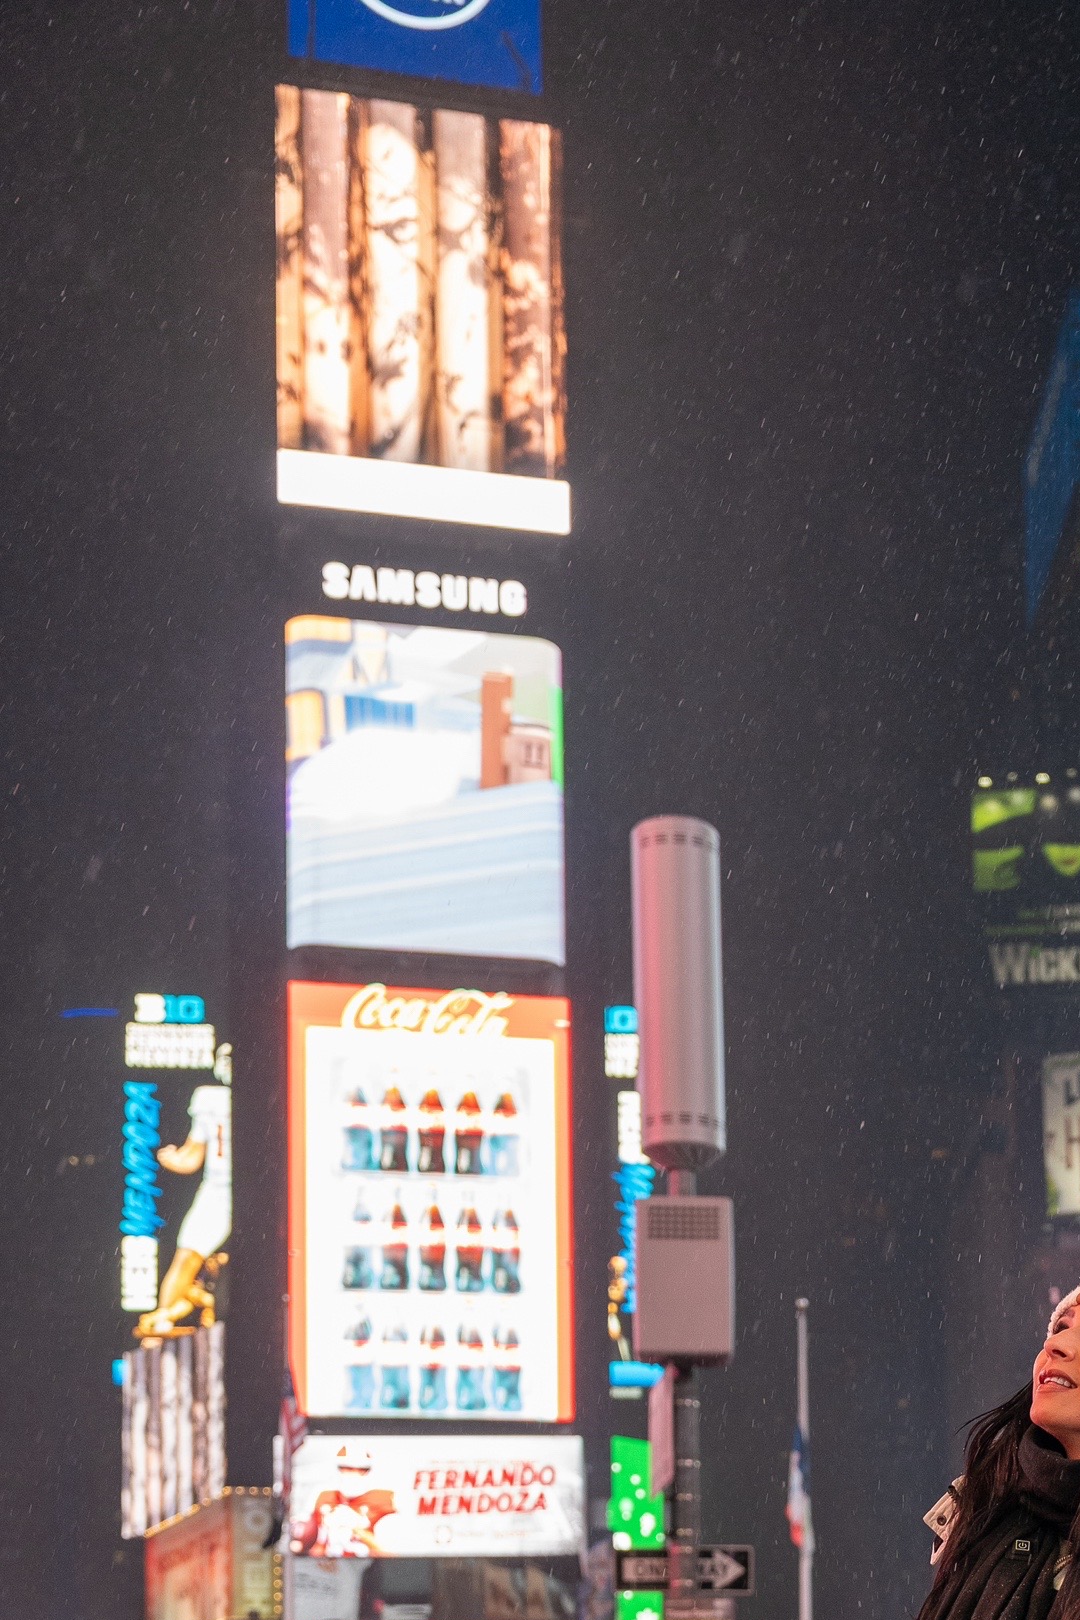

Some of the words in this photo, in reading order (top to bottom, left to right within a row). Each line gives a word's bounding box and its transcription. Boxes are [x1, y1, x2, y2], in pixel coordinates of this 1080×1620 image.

[321, 561, 528, 617] SAMSUNG
[413, 1461, 557, 1490] FERNANDO
[417, 1491, 547, 1516] MENDOZA
